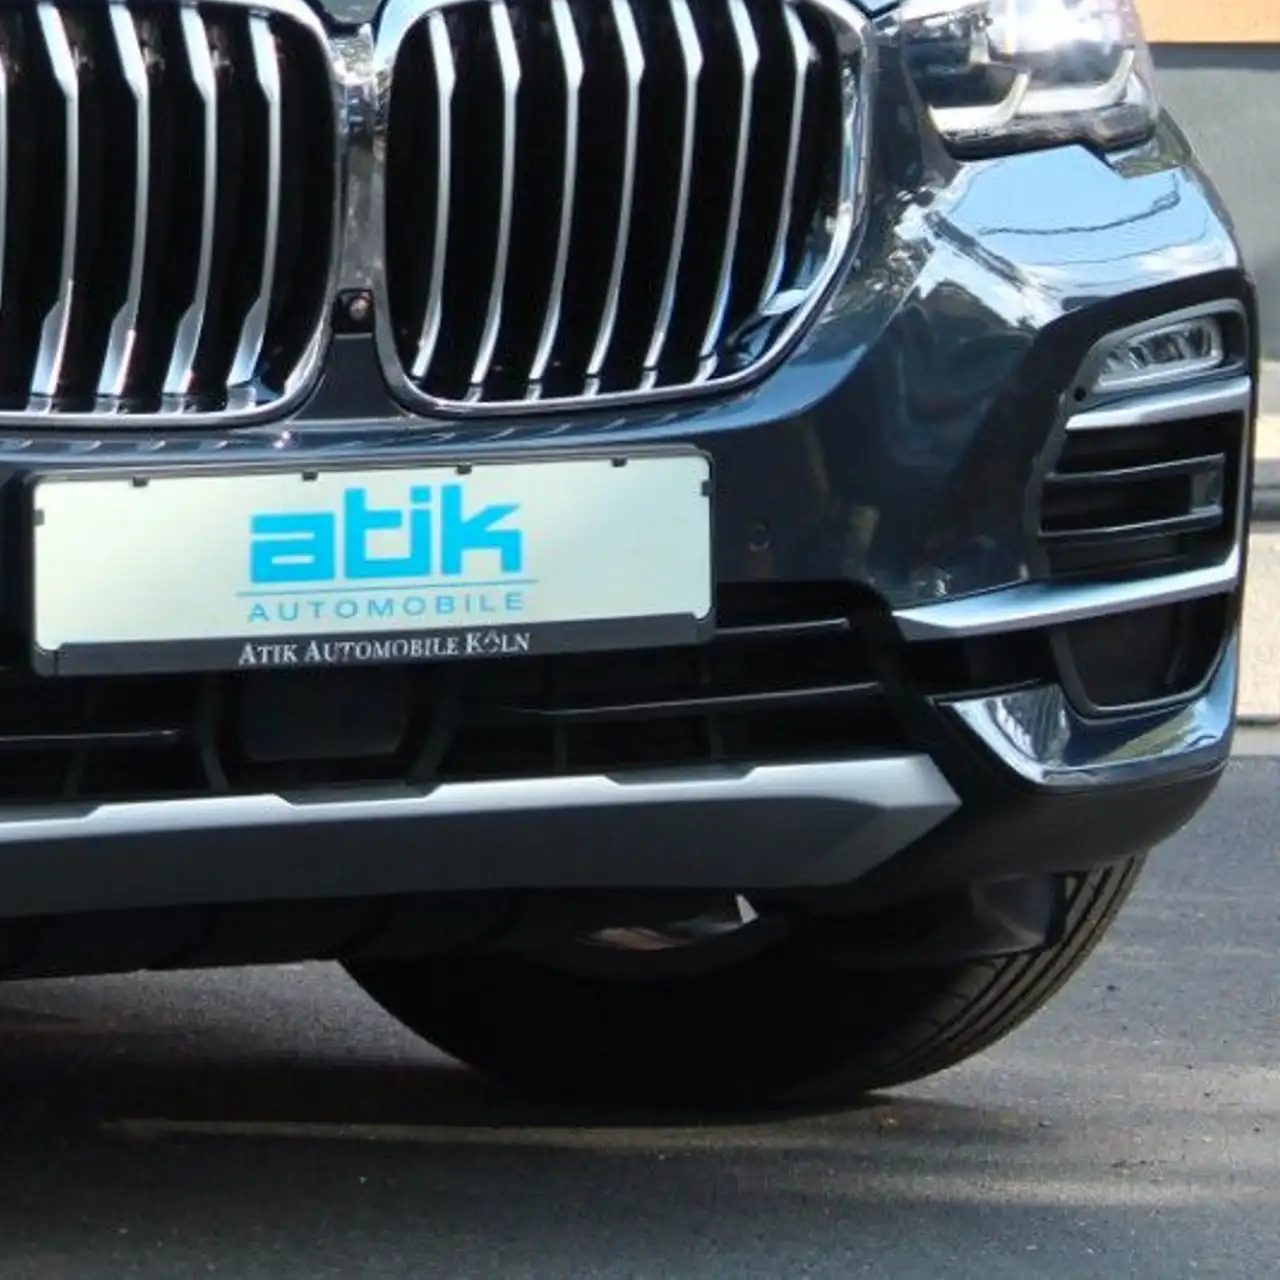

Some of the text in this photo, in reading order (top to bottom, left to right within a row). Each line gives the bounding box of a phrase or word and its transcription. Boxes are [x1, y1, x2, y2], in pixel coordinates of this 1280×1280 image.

[251, 484, 522, 583] atik
[248, 592, 524, 621] AUTOMOBILE
[239, 641, 298, 665] ATIK
[304, 635, 458, 663] AUTOMOBILE
